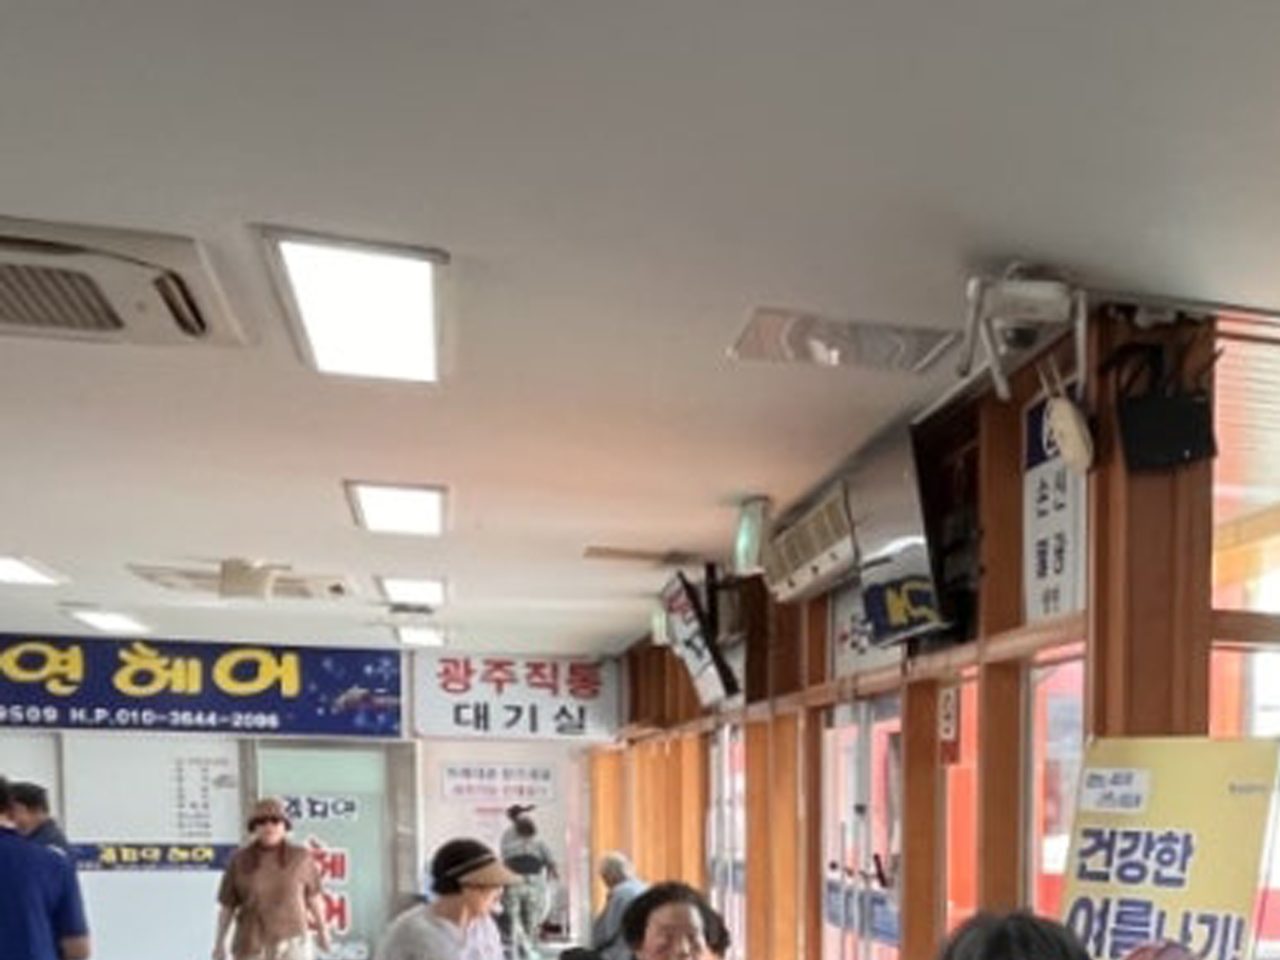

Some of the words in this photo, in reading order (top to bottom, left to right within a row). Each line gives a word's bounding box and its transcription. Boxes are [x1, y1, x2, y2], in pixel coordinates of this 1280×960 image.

[0, 641, 84, 696] 연
[113, 641, 300, 698] 헤어
[437, 656, 603, 699] 광주직통
[453, 702, 586, 735] 대기실
[1077, 828, 1195, 888] 건강한
